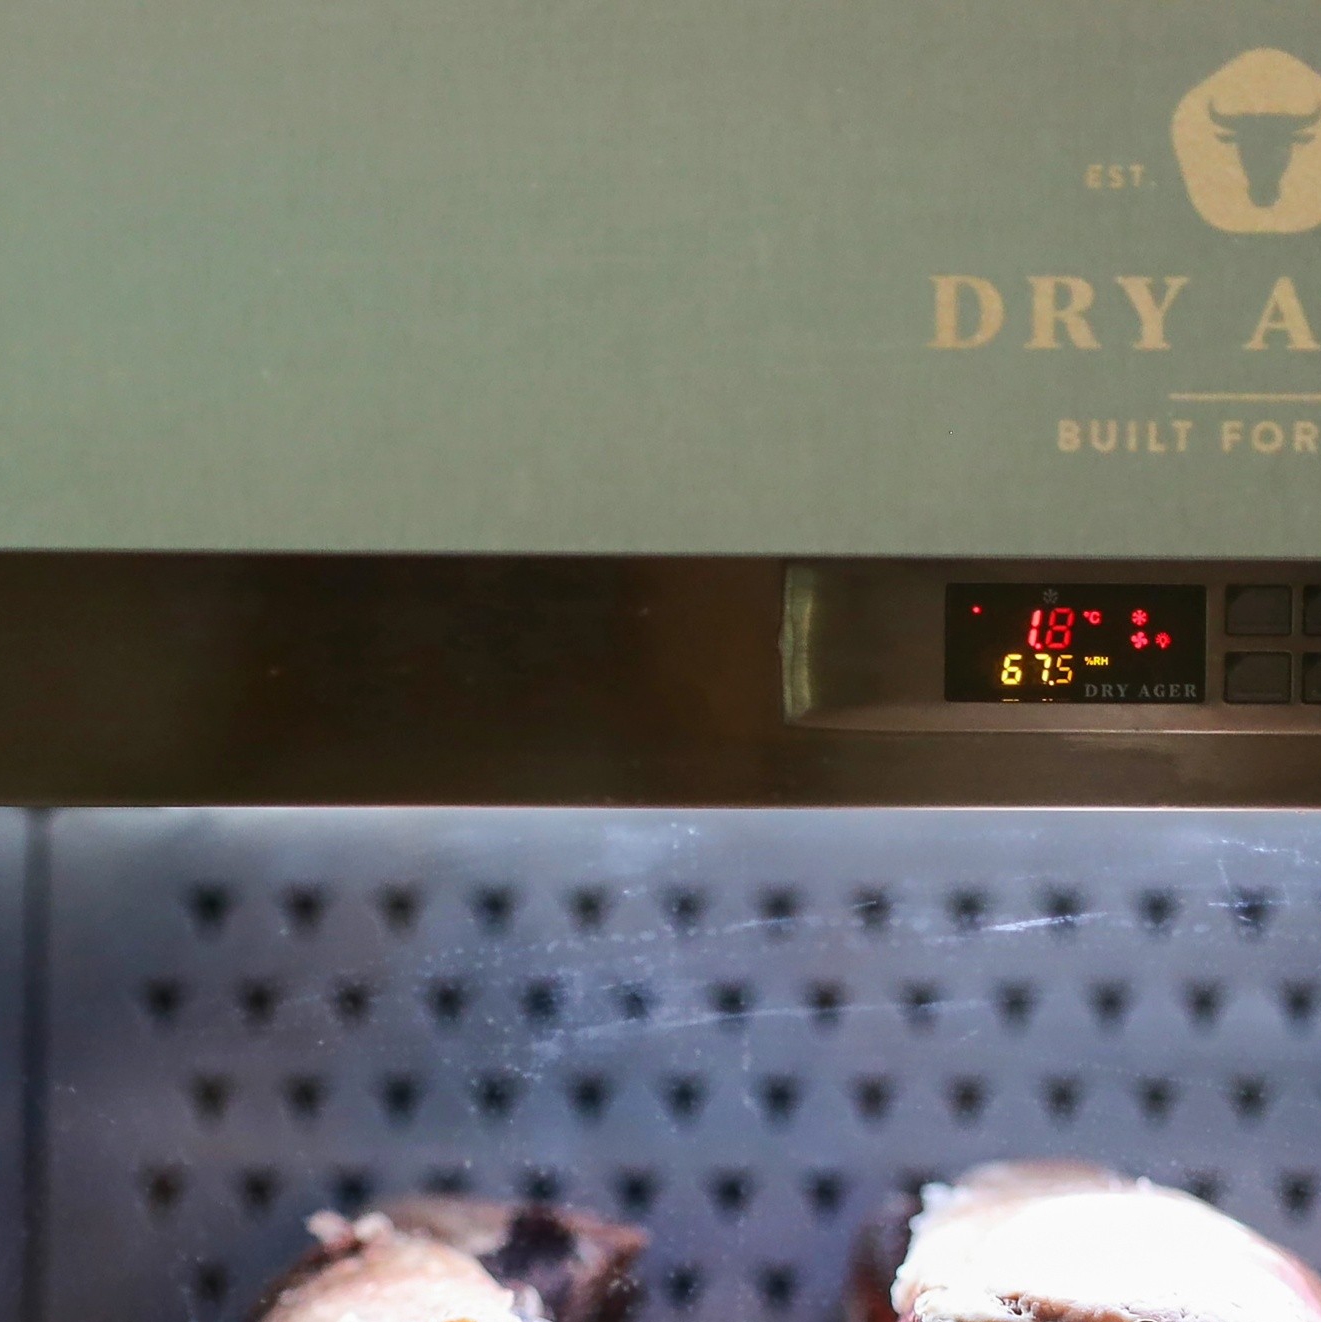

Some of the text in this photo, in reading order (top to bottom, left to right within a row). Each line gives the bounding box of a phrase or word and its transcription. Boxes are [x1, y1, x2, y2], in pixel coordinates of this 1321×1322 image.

[1084, 164, 1157, 189] EST.
[927, 273, 1190, 351] DRY
[1056, 419, 1193, 453] BUILT
[1221, 420, 1320, 454] FOR
[1000, 653, 1109, 686] 67.5 %RH
[1085, 683, 1198, 698] DRY AGER
